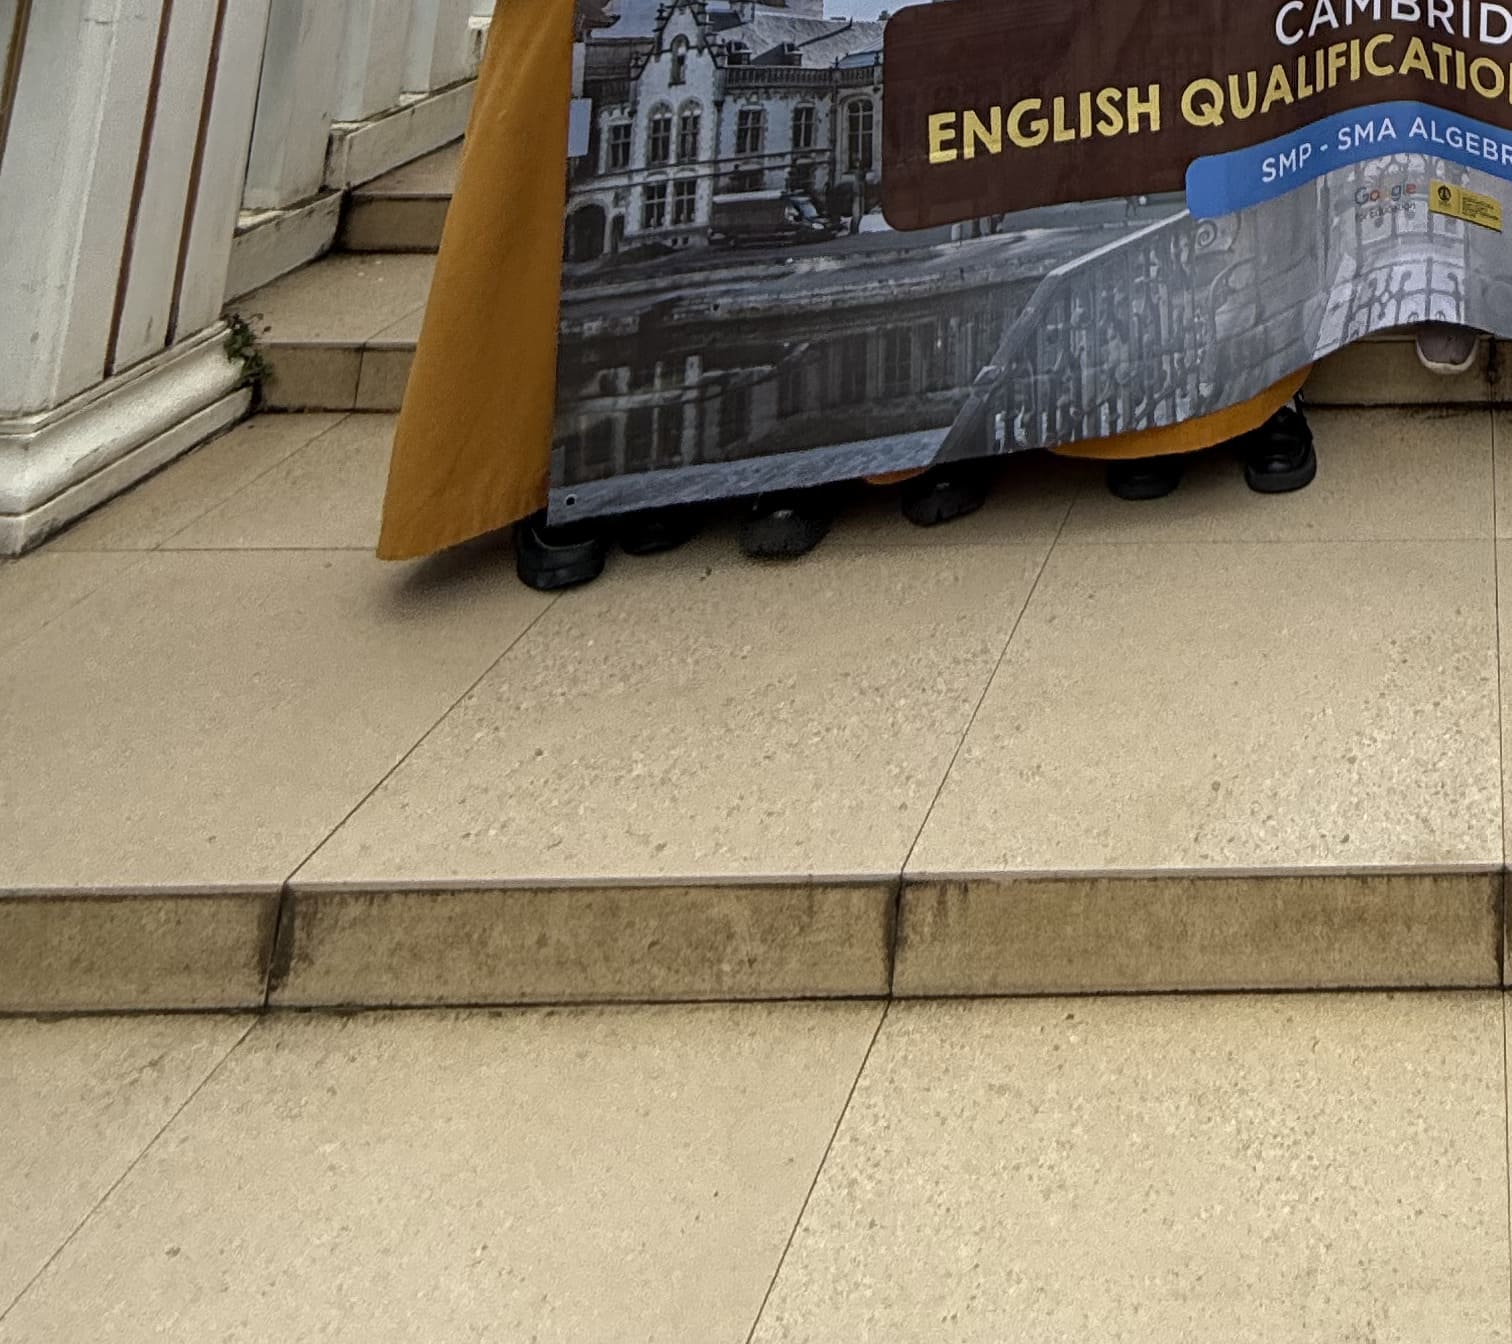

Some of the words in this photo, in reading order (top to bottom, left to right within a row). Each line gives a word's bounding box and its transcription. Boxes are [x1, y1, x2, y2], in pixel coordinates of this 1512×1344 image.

[928, 83, 1161, 164] ENGLISH
[1261, 142, 1312, 183] SMP
[1337, 116, 1397, 151] SMA
